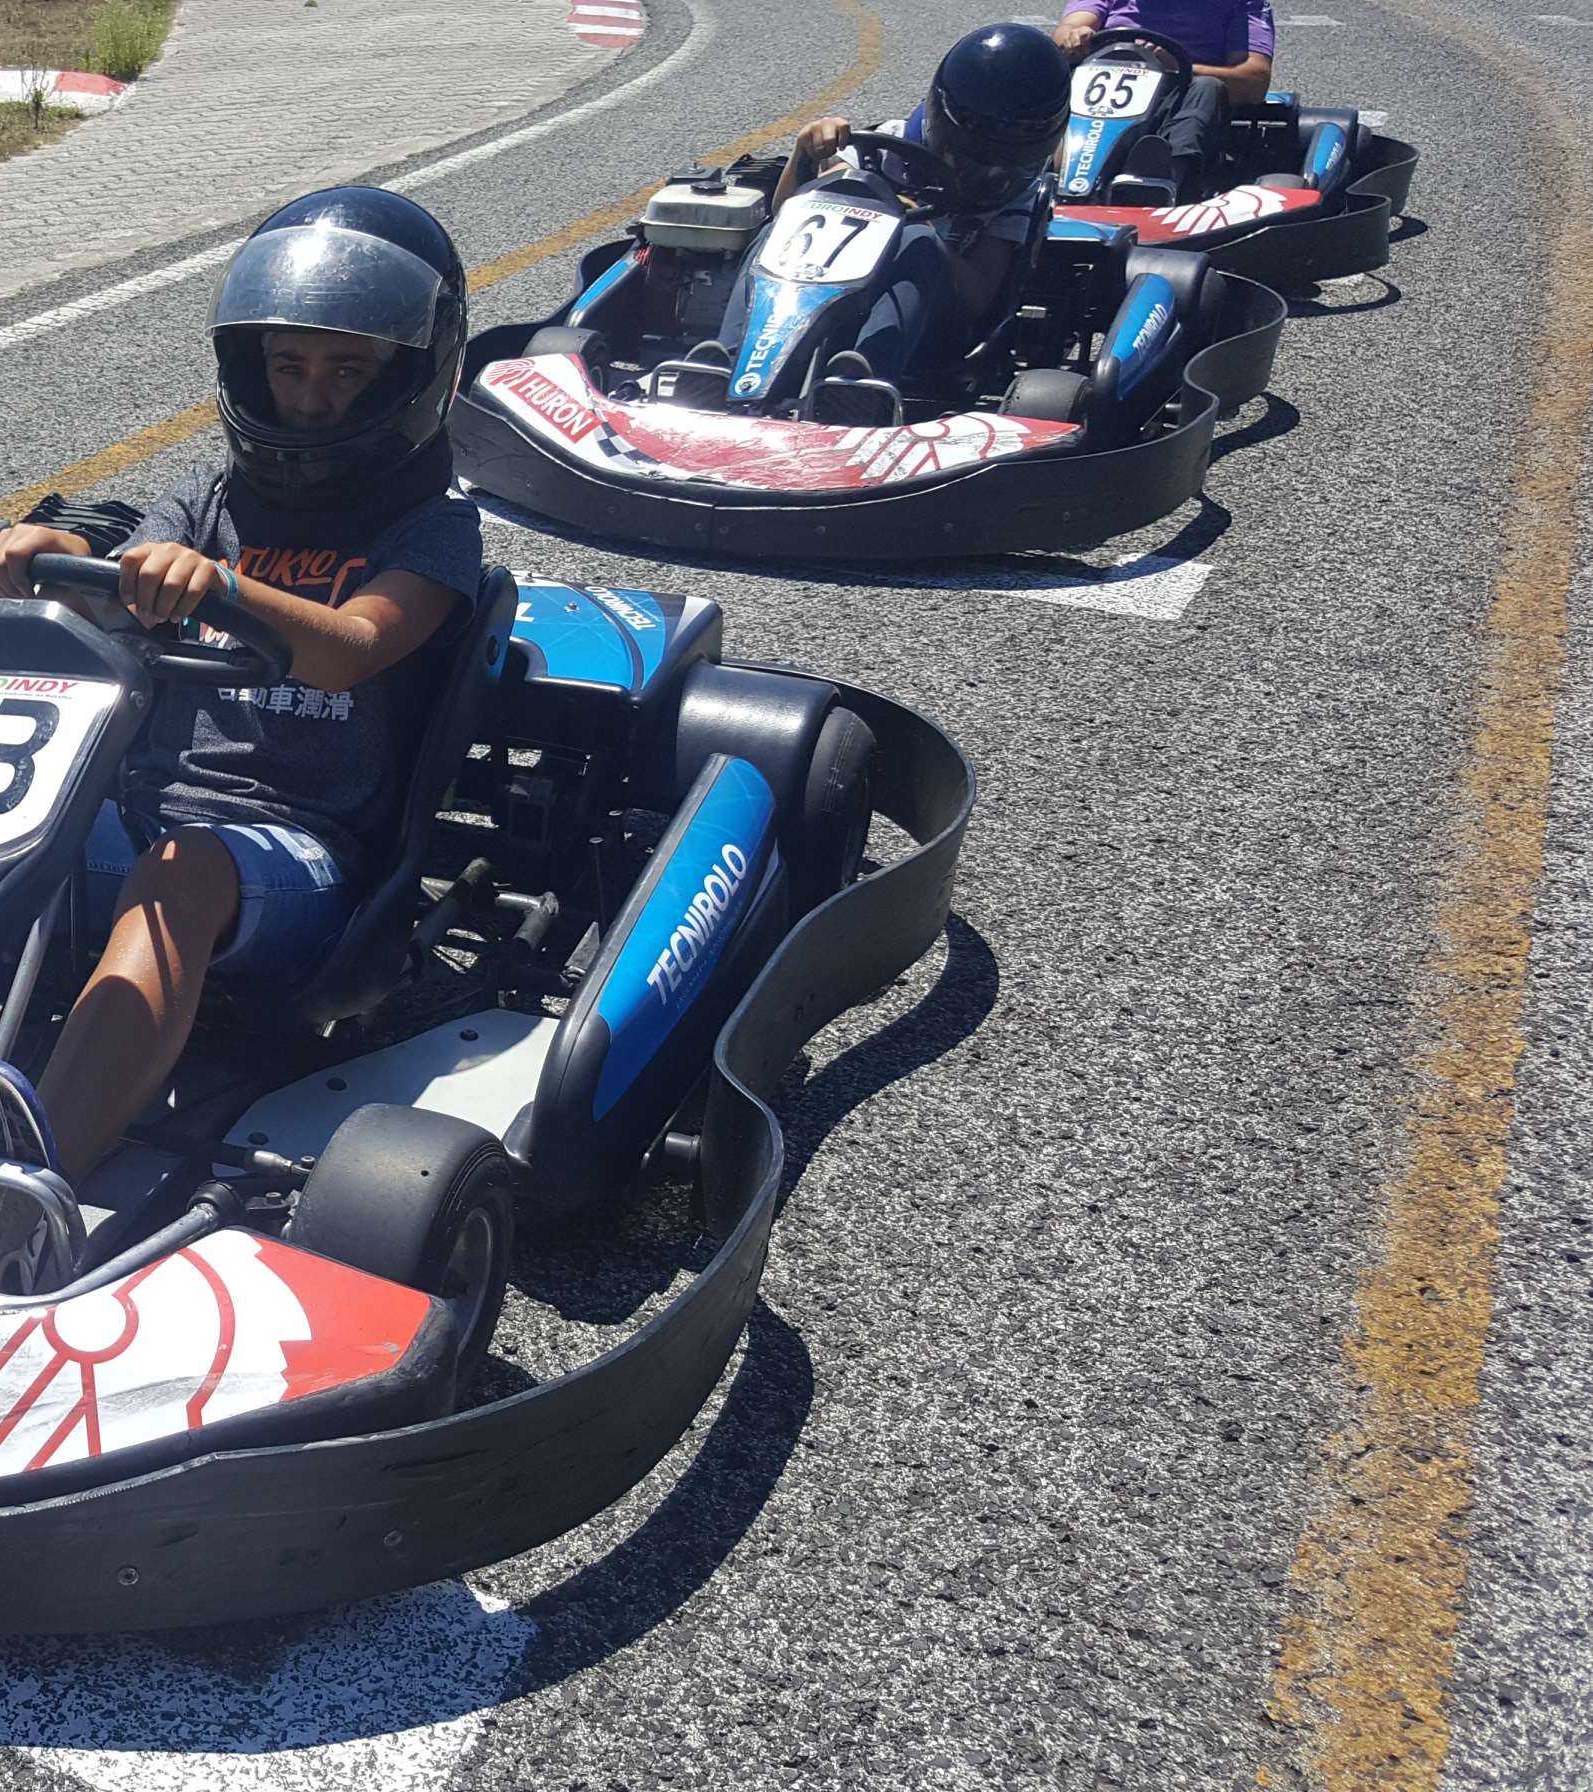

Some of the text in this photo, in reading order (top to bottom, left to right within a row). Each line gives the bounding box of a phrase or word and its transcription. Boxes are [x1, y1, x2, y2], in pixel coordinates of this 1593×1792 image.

[1083, 70, 1138, 110] 65
[1075, 119, 1105, 177] TECNIROLO
[778, 214, 871, 269] 67
[518, 377, 594, 436] HURON
[584, 586, 656, 631] TECNIROLO
[646, 843, 747, 1006] TECNIROLO
